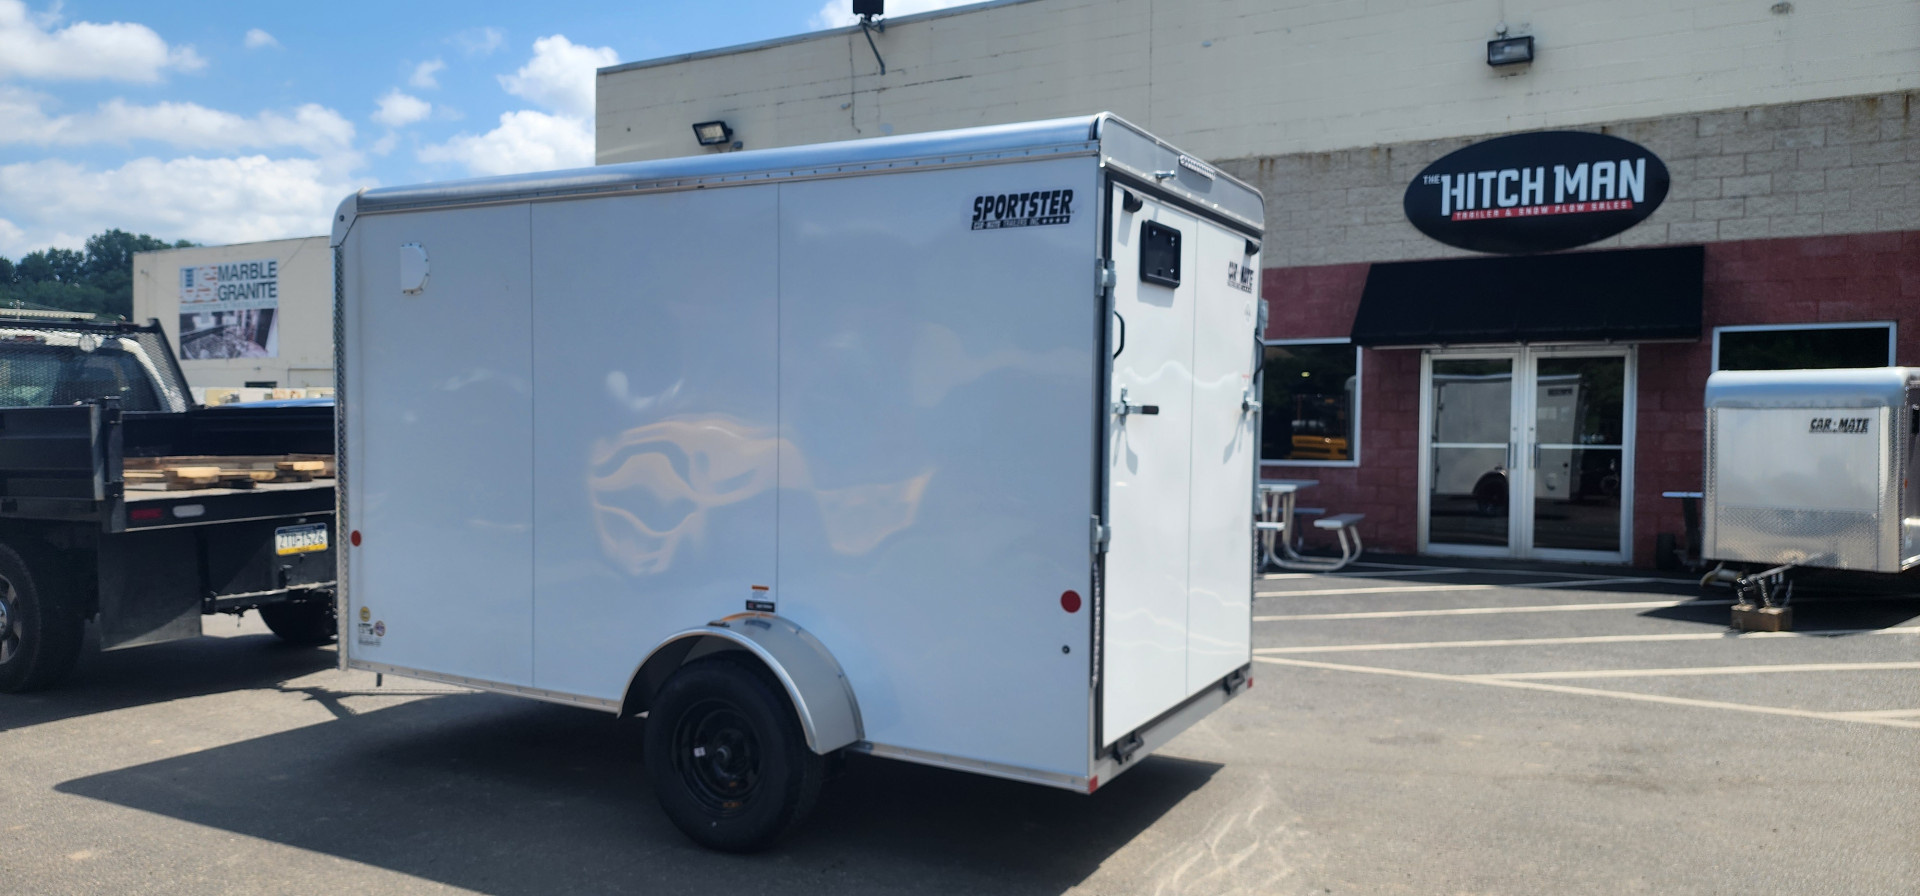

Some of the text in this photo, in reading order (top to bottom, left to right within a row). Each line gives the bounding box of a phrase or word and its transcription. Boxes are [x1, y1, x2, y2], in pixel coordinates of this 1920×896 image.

[1423, 174, 1441, 185] THE
[1441, 158, 1646, 216] HITCH MAN
[972, 189, 1073, 221] SPORTSTER
[1456, 201, 1628, 220] TRAILER & SNOW PLOW SALES
[218, 261, 277, 281] MARBLE
[218, 281, 277, 301] GRANITE
